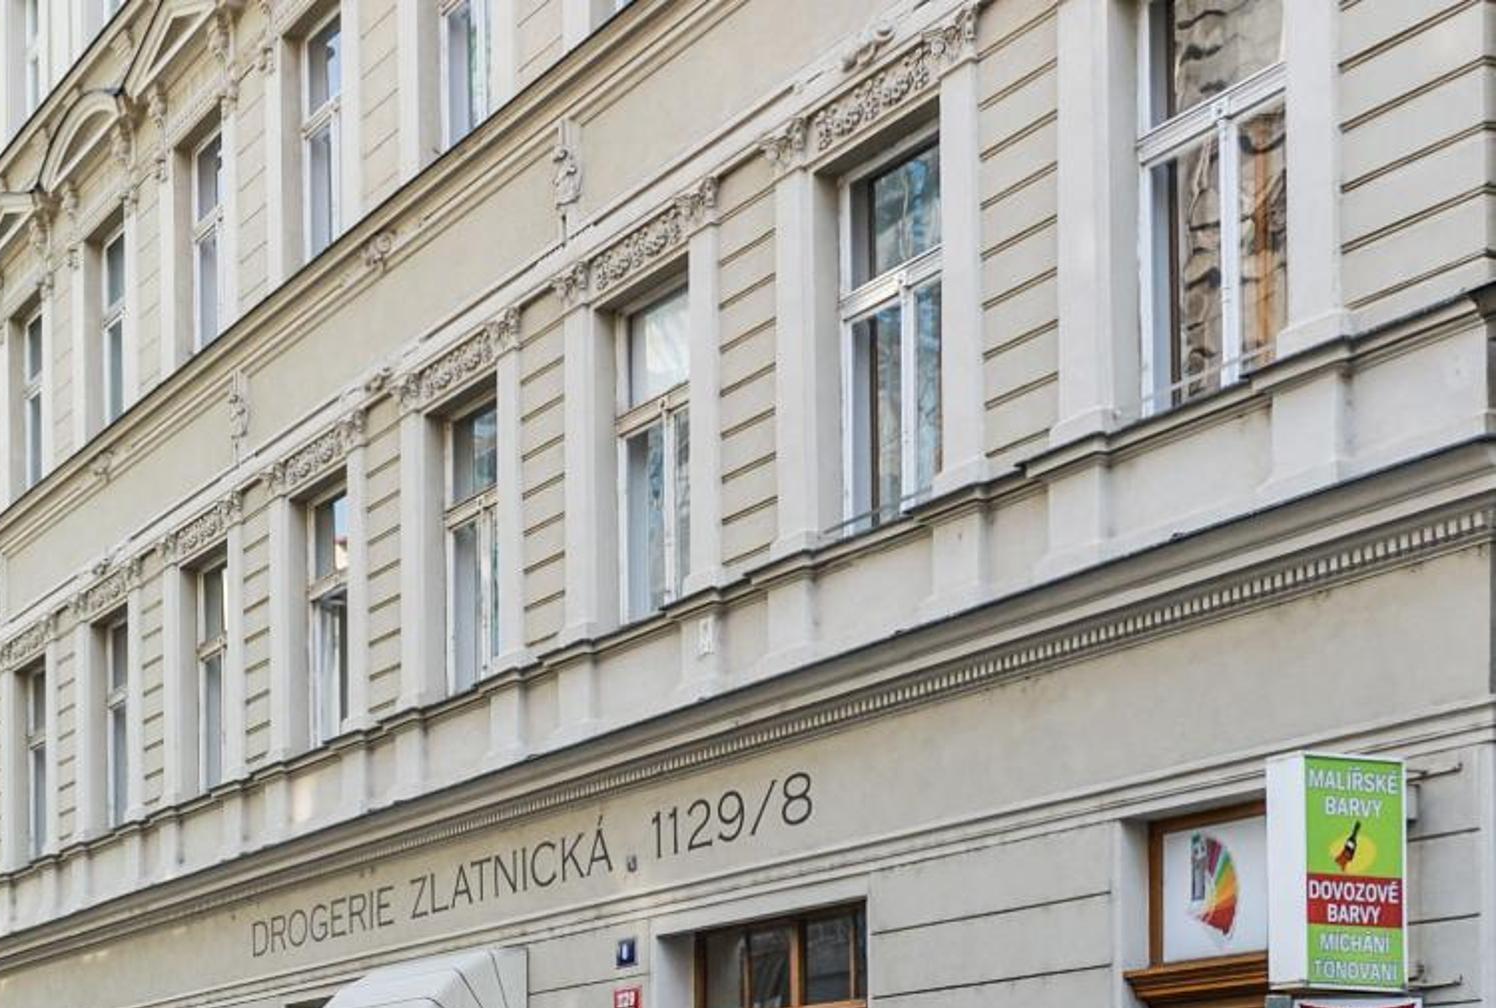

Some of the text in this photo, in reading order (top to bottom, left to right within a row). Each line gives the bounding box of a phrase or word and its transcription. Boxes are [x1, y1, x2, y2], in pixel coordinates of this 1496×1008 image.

[1324, 796, 1384, 819] BARVY
[251, 771, 814, 959] DROGERIE ZLATNICKÁ 1129/8
[1307, 879, 1400, 904] DOVOZOVÉ
[1326, 903, 1381, 925] BARVY
